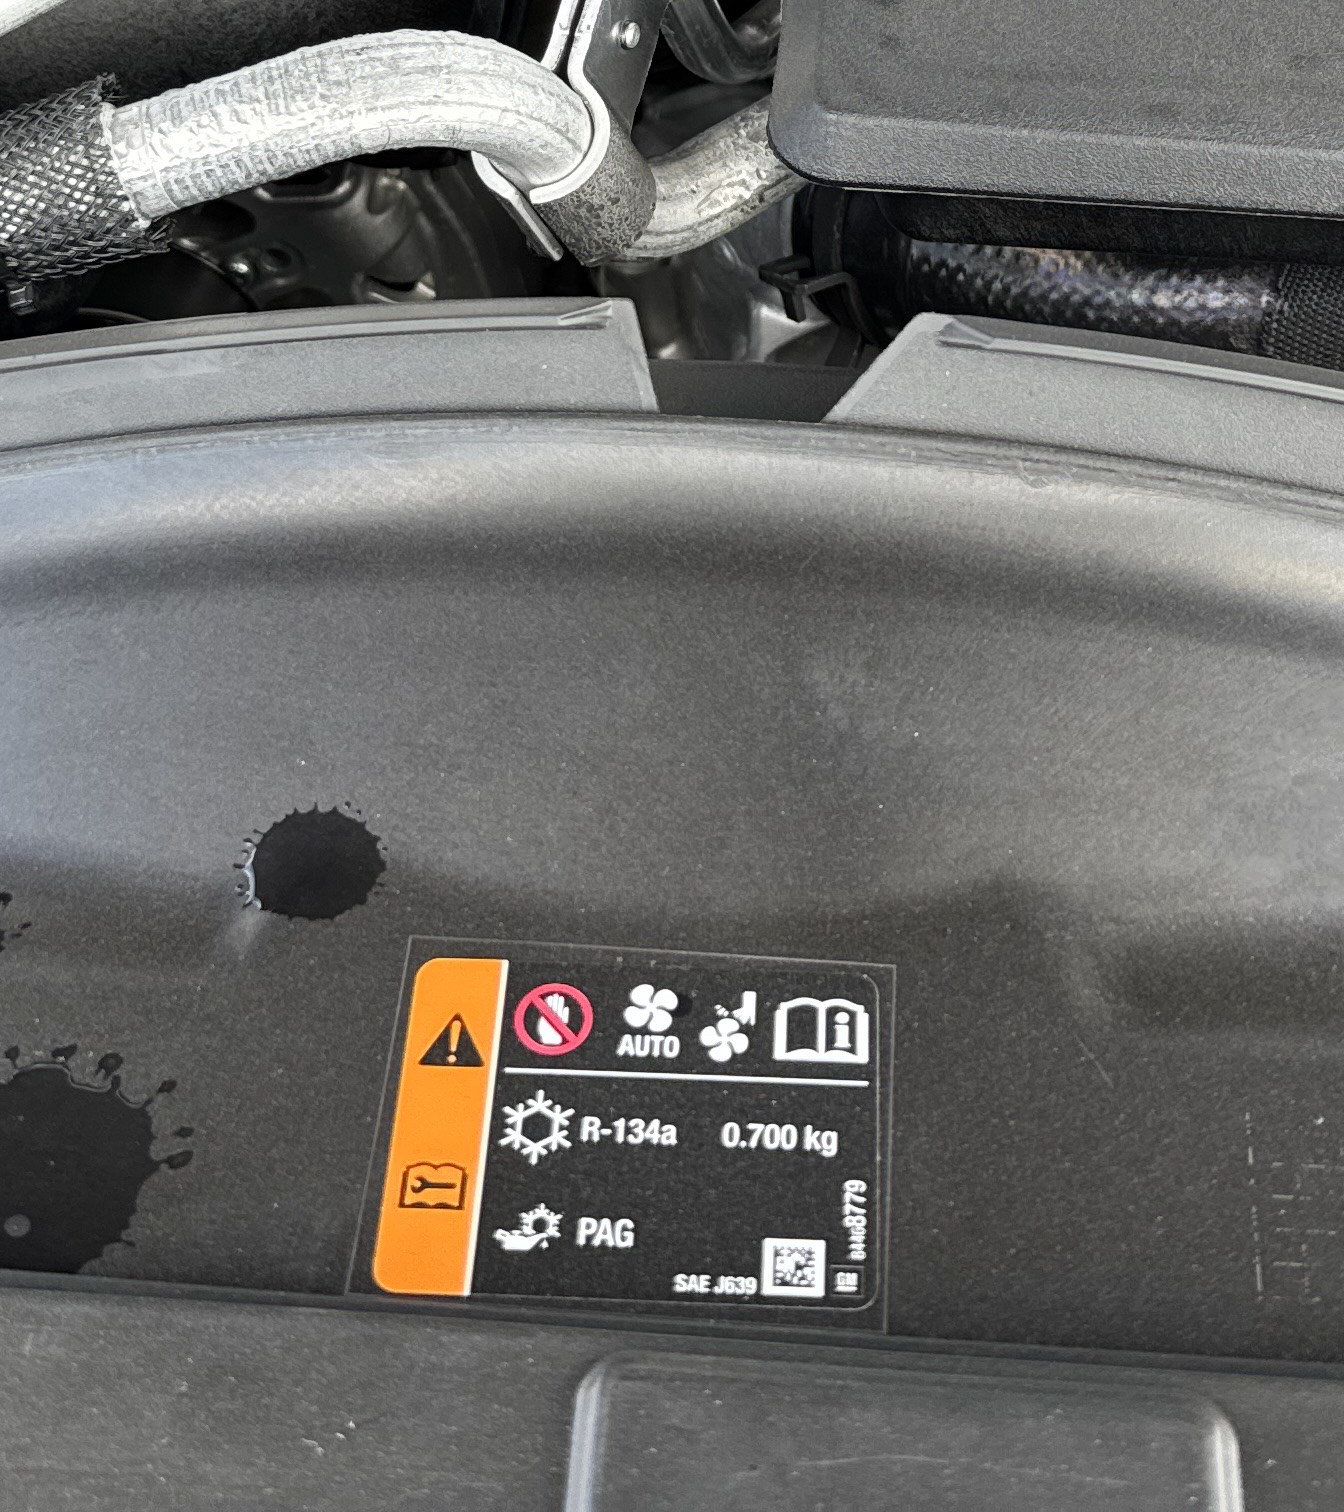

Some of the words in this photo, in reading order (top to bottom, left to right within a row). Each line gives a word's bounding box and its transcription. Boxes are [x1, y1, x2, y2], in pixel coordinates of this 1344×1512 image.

[616, 1034, 680, 1059] AUTO
[580, 1115, 678, 1146] R-134a
[721, 1121, 798, 1151] 0.700
[803, 1124, 839, 1158] kg
[576, 1216, 635, 1248] PAG
[673, 1273, 712, 1295] SAE
[714, 1275, 758, 1296] J639
